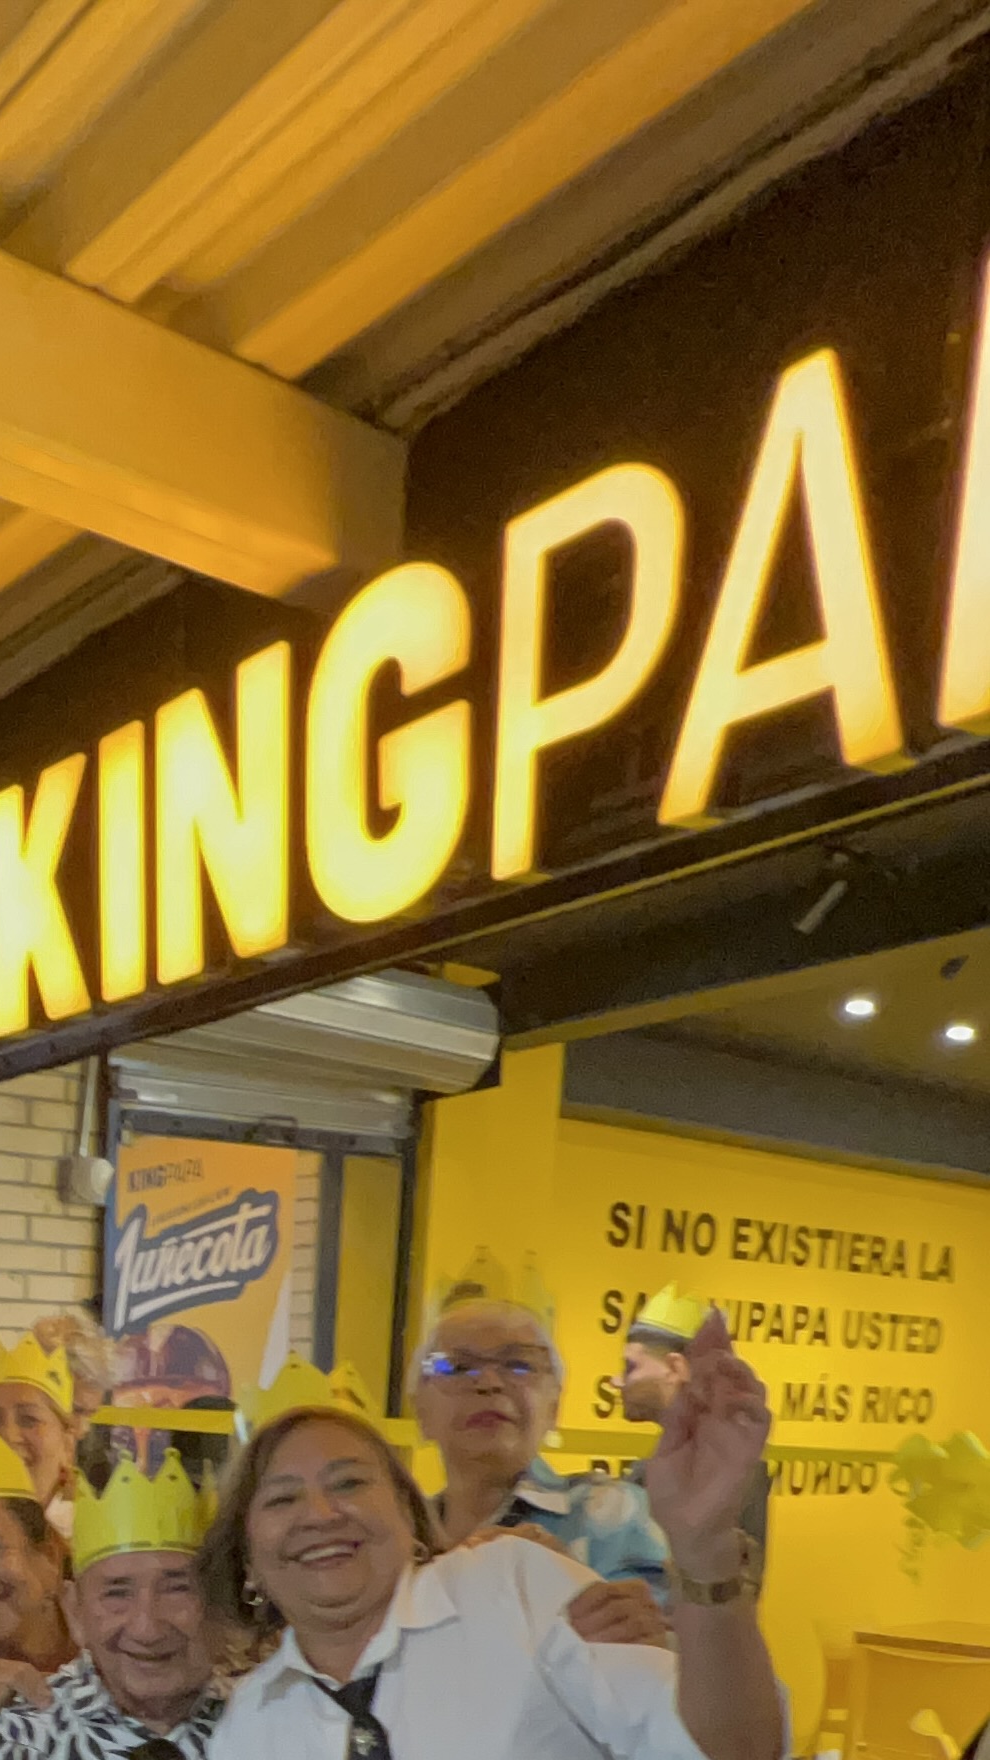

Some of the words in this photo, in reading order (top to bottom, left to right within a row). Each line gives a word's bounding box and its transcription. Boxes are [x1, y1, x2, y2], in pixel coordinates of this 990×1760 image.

[606, 1202, 647, 1250] SI
[663, 1208, 717, 1256] NO
[730, 1217, 909, 1279] EXISTIERA
[919, 1242, 955, 1283] LA
[843, 1311, 945, 1354] USTED
[779, 1374, 852, 1423] MÁS
[861, 1385, 936, 1423] RICO
